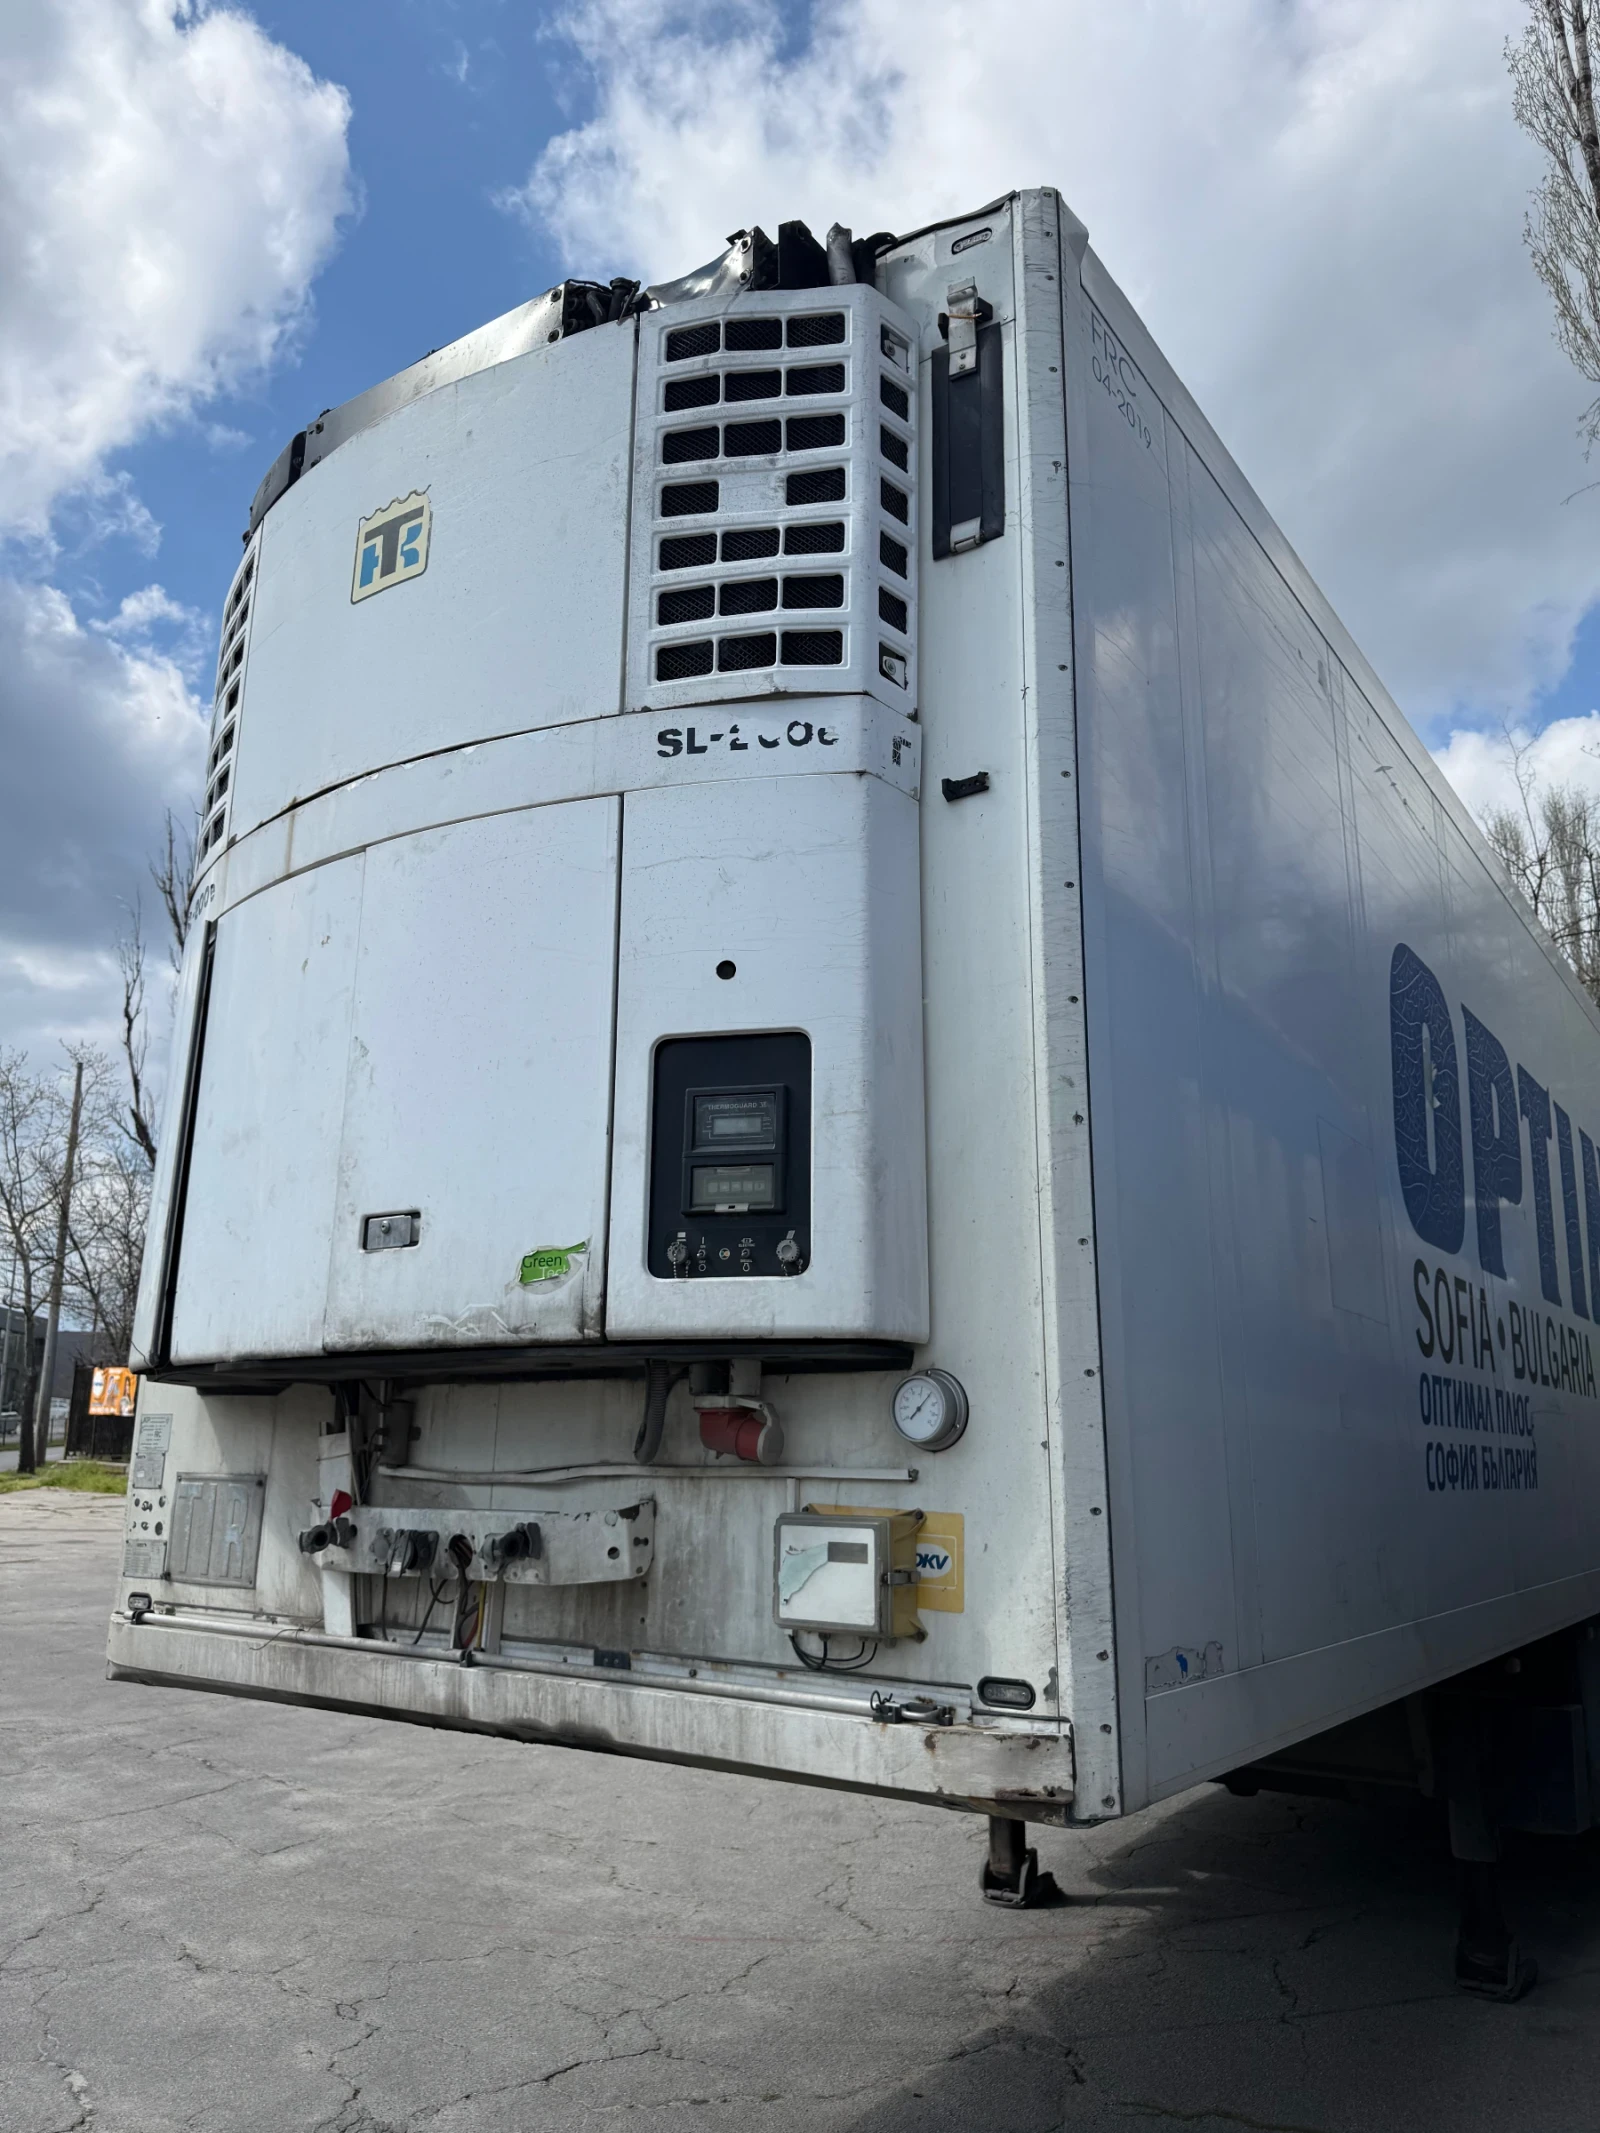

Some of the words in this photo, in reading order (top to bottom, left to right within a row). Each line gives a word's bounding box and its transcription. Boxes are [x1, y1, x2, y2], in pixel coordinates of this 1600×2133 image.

[1091, 311, 1137, 398] FRC
[1092, 356, 1151, 449] 04-2019
[522, 1256, 562, 1268] Green
[1413, 1259, 1495, 1372] SOFIA
[1508, 1300, 1597, 1399] BULGARIA
[1419, 1372, 1494, 1433] ОПТИМАЛ
[1426, 1442, 1478, 1492] СОФИЯ
[1481, 1445, 1538, 1490] БЪЛГАРИЯ
[179, 1482, 249, 1578] TIR
